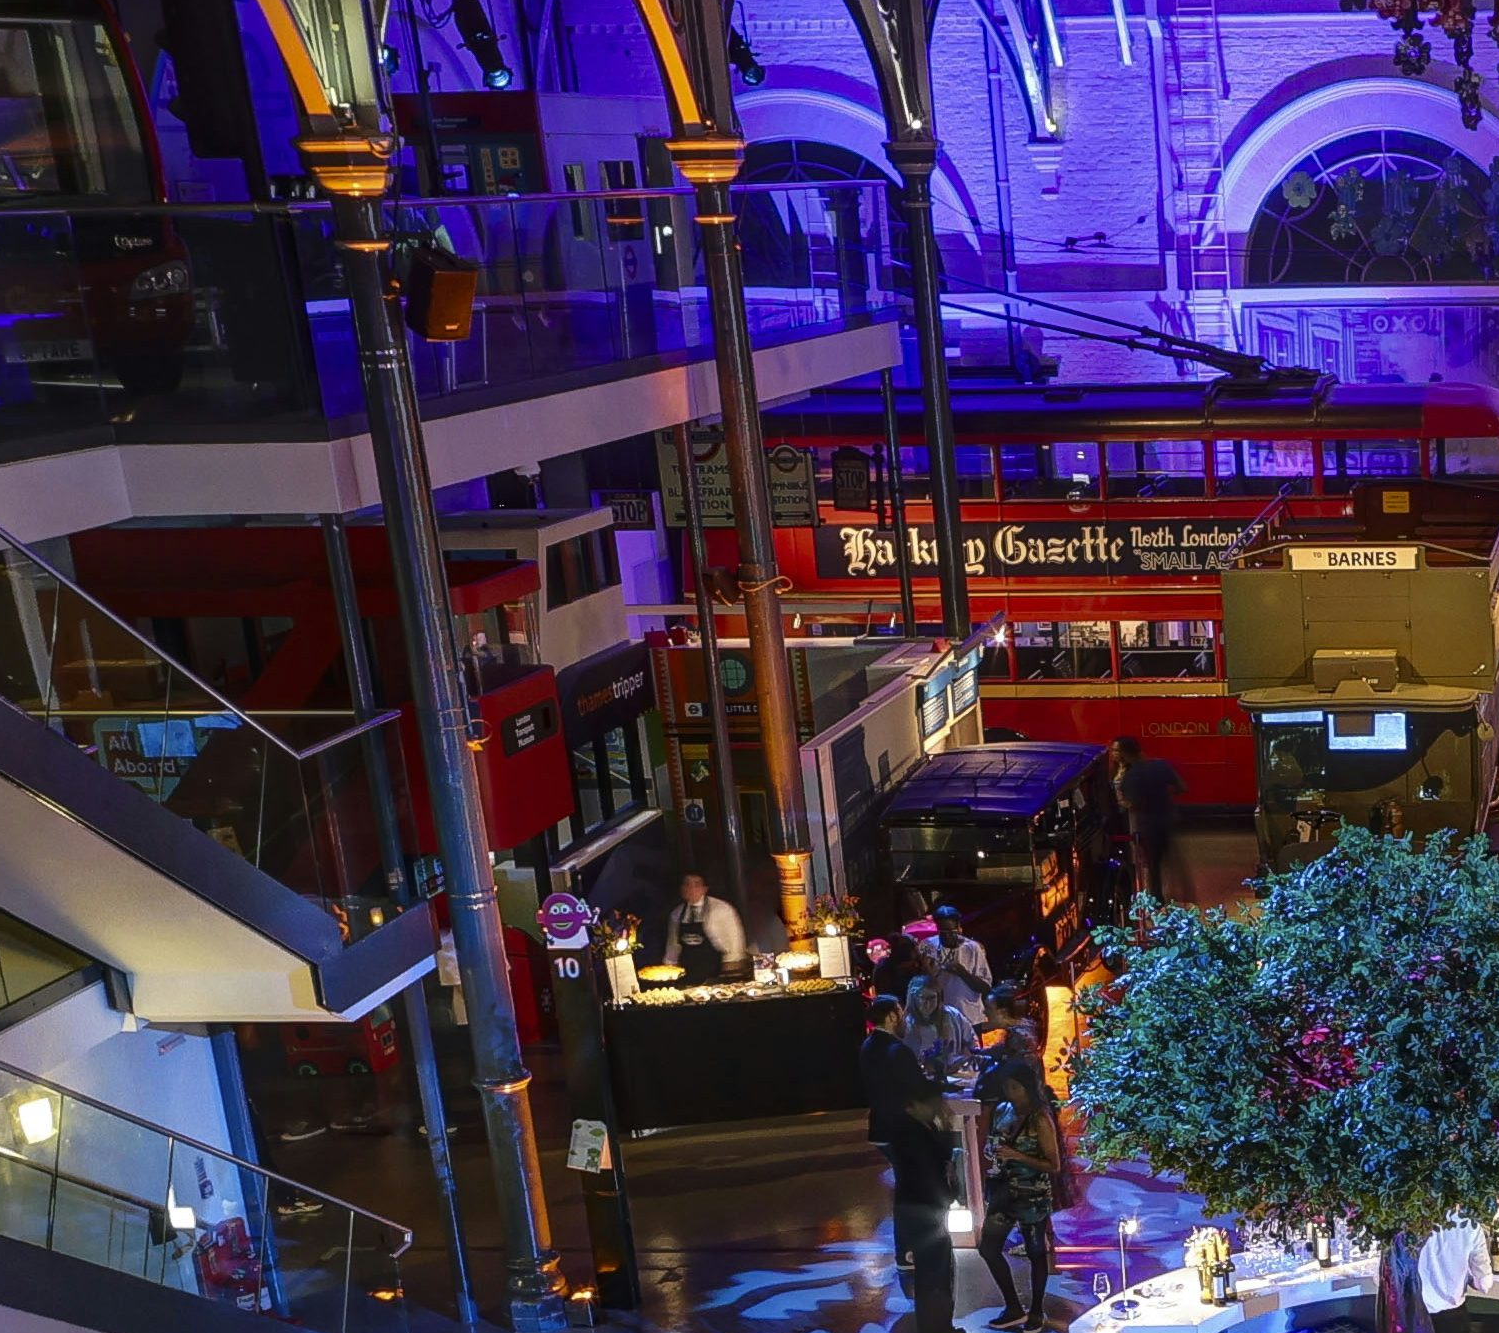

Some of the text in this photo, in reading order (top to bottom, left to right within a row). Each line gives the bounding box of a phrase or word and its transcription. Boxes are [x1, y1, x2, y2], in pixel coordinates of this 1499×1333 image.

[1372, 314, 1432, 335] OXO
[836, 470, 866, 490] STOP
[994, 524, 1125, 565] Gazette
[1130, 525, 1175, 549] North
[1328, 550, 1398, 569] BARNES
[1141, 721, 1210, 738] LONDON
[554, 957, 580, 979] 10
